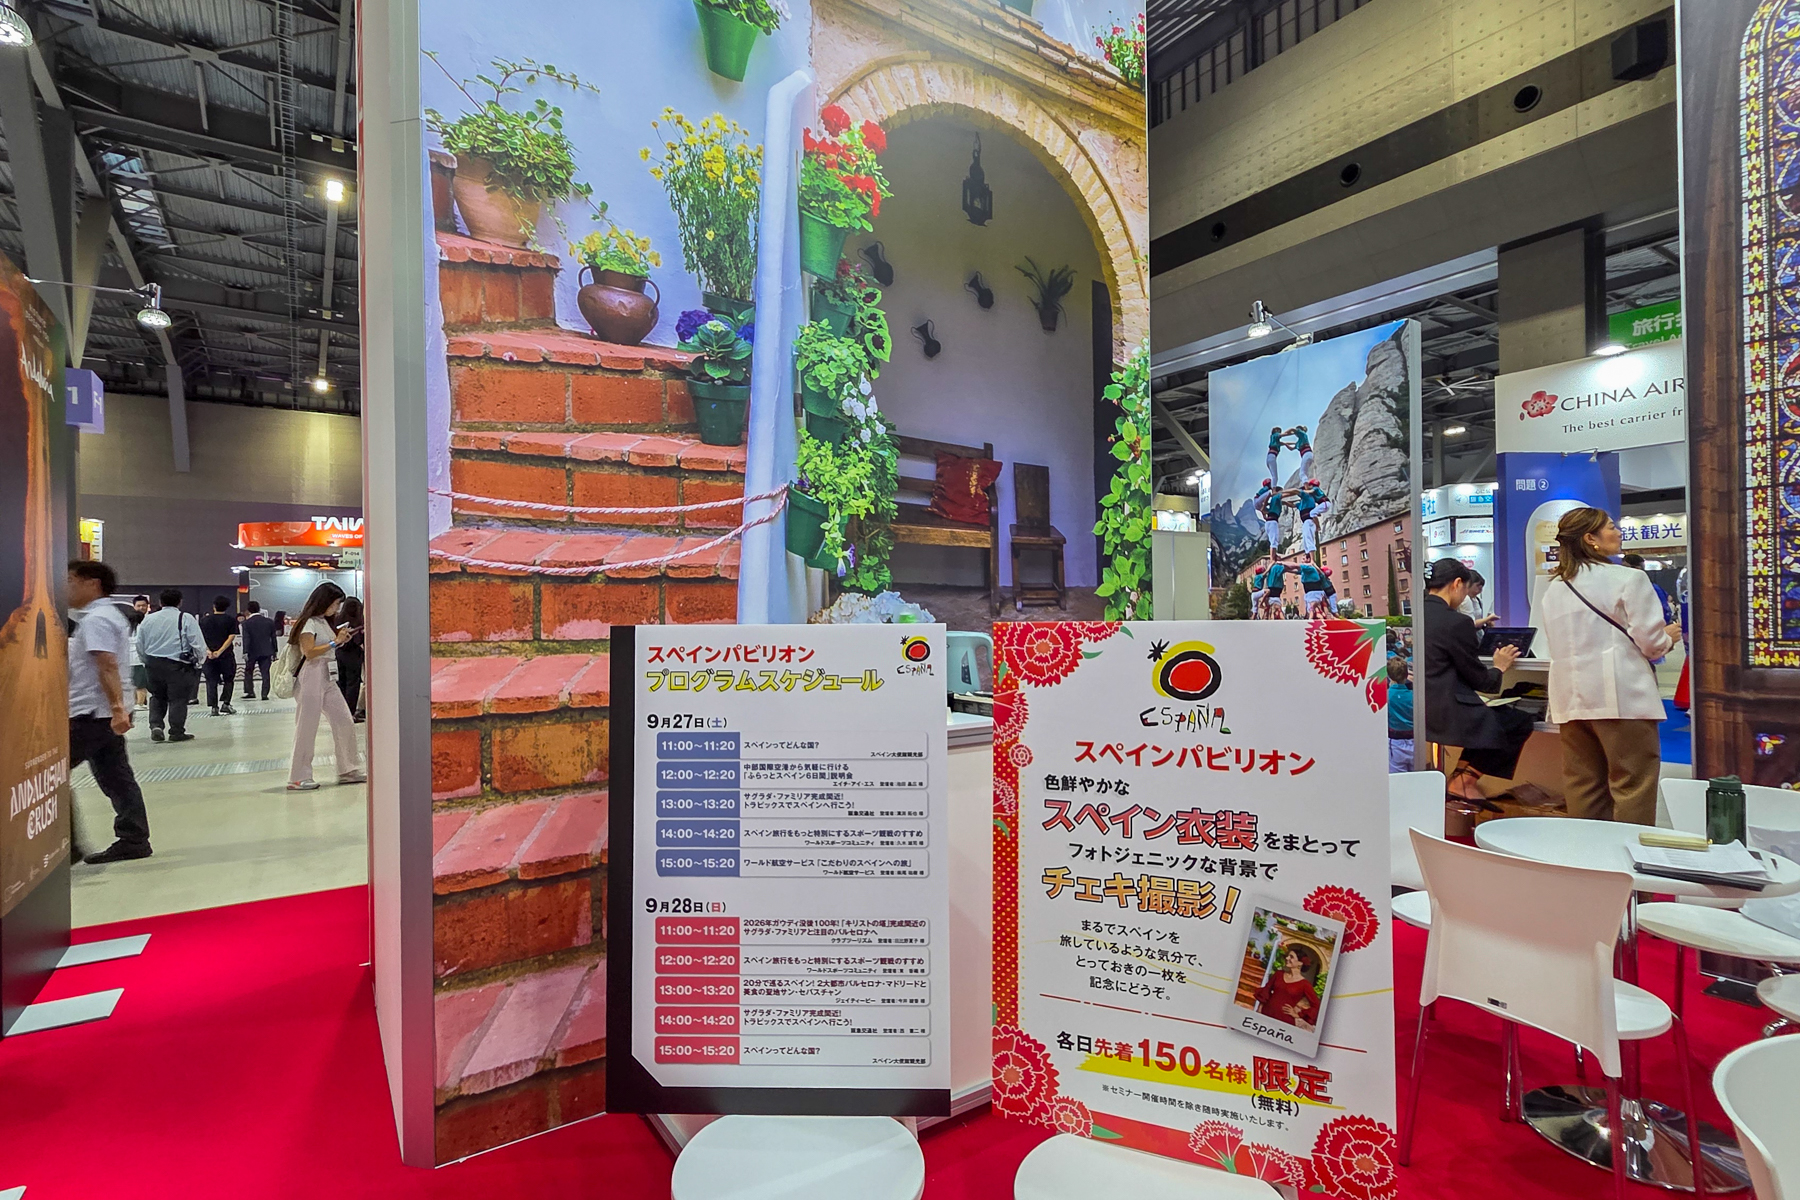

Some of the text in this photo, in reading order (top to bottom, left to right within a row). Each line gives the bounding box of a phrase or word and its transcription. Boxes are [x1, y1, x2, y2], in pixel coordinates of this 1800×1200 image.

[1560, 387, 1635, 411] CHINA
[1562, 423, 1584, 434] The
[1588, 417, 1615, 430] best
[1620, 411, 1666, 426] carrier
[647, 645, 815, 664] スペインパビリオン
[645, 668, 885, 692] プログラムスケジュール
[647, 714, 728, 729] 9月27日(土)
[1139, 704, 1231, 734] ESPAÑA
[662, 741, 735, 750] 11:00～11:20
[744, 742, 820, 750] スペインってどんな国?
[1074, 741, 1315, 776] スペインパビリオン
[661, 770, 735, 780] 12:00～12:20
[1044, 774, 1130, 796] 色鮮やかな
[661, 800, 735, 809] 13:00～13:20
[661, 829, 735, 838] 14:00～14:20
[660, 858, 735, 868] 15:00～15:20
[1069, 842, 1278, 881] フォトジェニックな背景で
[1042, 866, 1241, 924] チェキ撮影!
[646, 898, 726, 913] 9月28日(日)
[660, 926, 735, 936] 11:00～11:20
[1080, 919, 1180, 944] まるでスペインを
[660, 956, 735, 966] 12:00～12:20
[1059, 934, 1203, 968] 旅しているような気分で、
[1076, 955, 1187, 984] とっておきの一枚を
[660, 986, 735, 996] 13:00～13:20
[1090, 975, 1172, 1001] 記念にどうぞ。
[660, 1016, 735, 1026] 14:00～14:20
[1242, 1015, 1294, 1045] España
[659, 1046, 735, 1056] 15:00～15:20
[1250, 1095, 1300, 1118] (無料)
